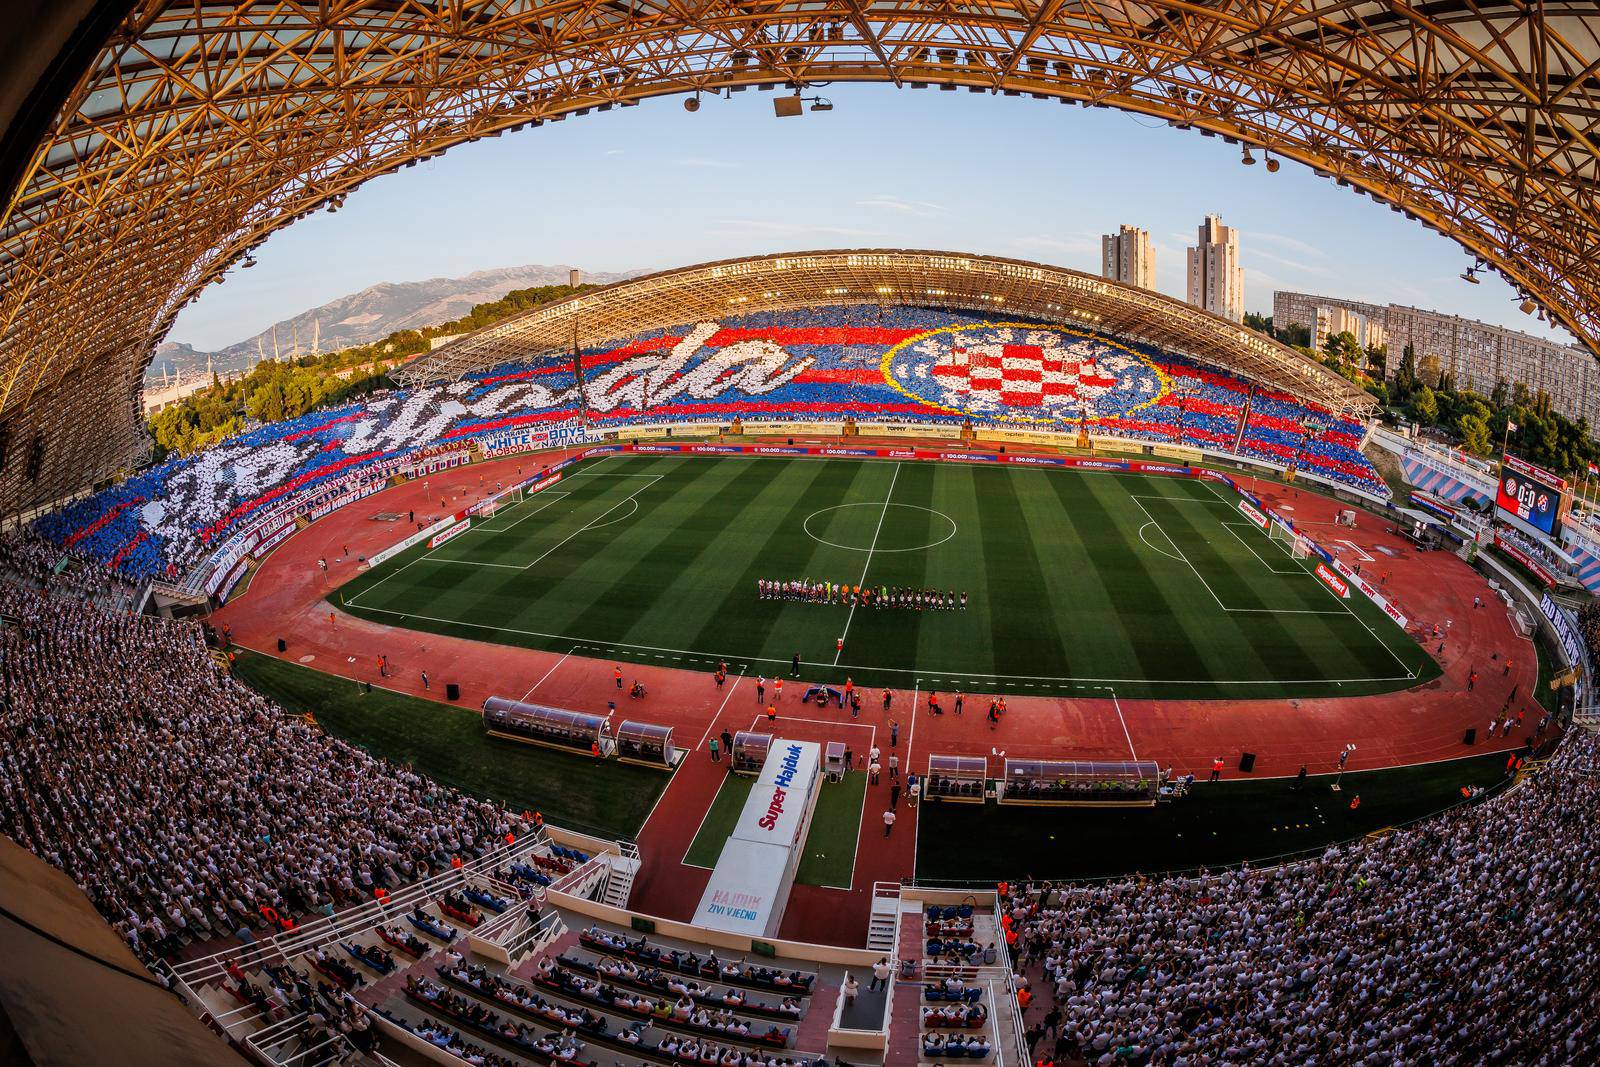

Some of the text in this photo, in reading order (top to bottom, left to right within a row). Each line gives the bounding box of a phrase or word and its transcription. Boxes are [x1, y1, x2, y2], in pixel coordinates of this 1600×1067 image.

[485, 425, 585, 450] WHITE BOYS
[285, 484, 349, 519] TORCIDA
[1317, 565, 1346, 593] SuperSport
[1540, 592, 1556, 620] BAD
[758, 744, 803, 832] Super Hajduk
